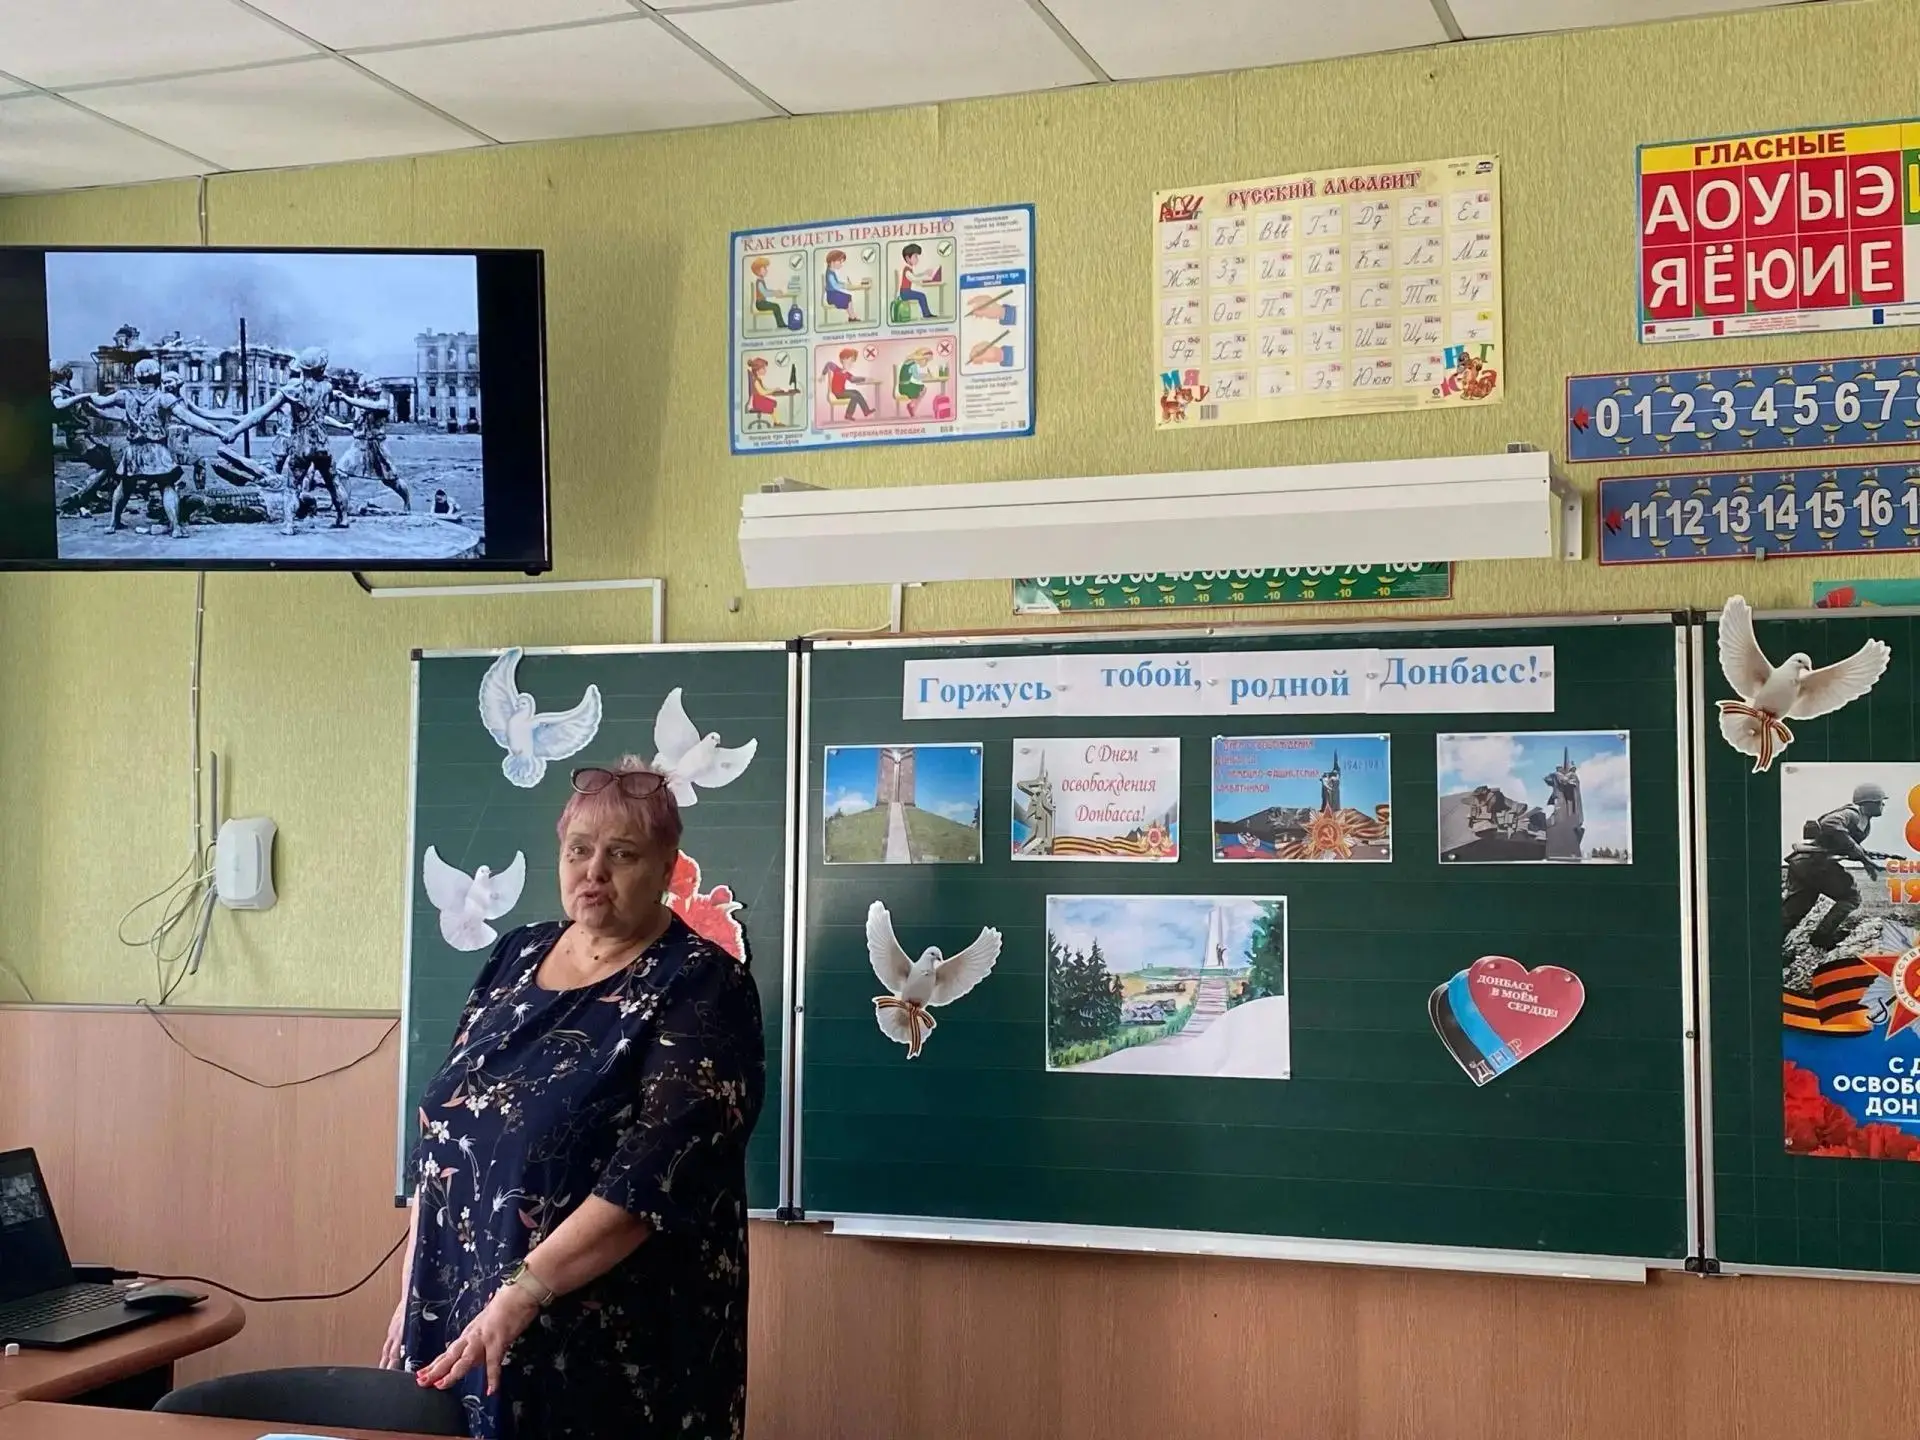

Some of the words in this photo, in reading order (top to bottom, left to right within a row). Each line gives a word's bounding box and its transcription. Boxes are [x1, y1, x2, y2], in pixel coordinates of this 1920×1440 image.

[1694, 132, 1845, 166] ГЛАСНЫЕ
[1227, 178, 1315, 209] РУССКИЙ
[1323, 170, 1421, 195] АЛФАВИТ
[742, 237, 775, 252] КАК
[781, 228, 844, 248] СИДЕТЬ
[849, 221, 955, 241] ПРАВИЛЬНО
[1615, 377, 1629, 387] +1
[1655, 375, 1670, 384] +1
[1696, 372, 1711, 381] +1
[1737, 370, 1752, 379] +1
[1778, 366, 1793, 376] +1
[1818, 363, 1834, 373] +1
[1860, 360, 1877, 370] +1
[1901, 358, 1916, 367] +1
[1596, 398, 1620, 437] 01234567
[1634, 395, 1651, 435] 01234567
[1671, 393, 1695, 433] 01234567
[1712, 390, 1736, 430] 01234567
[1751, 387, 1778, 427] 01234567
[1793, 385, 1819, 426] 01234567
[1835, 382, 1861, 423] 01234567
[1874, 380, 1900, 420] 01234567
[1619, 447, 1630, 456] -1
[1659, 444, 1670, 453] -1
[1701, 442, 1712, 451] -1
[1742, 439, 1753, 448] -1
[1783, 437, 1794, 446] -1
[1824, 435, 1835, 444] -1
[1866, 432, 1878, 441] -1
[1906, 430, 1918, 439] -1
[1656, 480, 1670, 489] +1
[1697, 477, 1711, 486] +1
[1738, 475, 1753, 484] +1
[1780, 473, 1795, 482] +1
[1822, 470, 1837, 479] +1
[1863, 468, 1879, 477] +1
[1625, 501, 1657, 538] 11
[1666, 499, 1705, 536] 12
[1712, 496, 1751, 533] 13
[1758, 493, 1799, 531] 14
[1805, 491, 1845, 529] 15
[1853, 488, 1894, 527] 16
[1901, 487, 1920, 525] 1
[1655, 549, 1666, 557] -1
[1696, 547, 1707, 555] -1
[1737, 544, 1748, 552] -1
[1779, 543, 1790, 552] -1
[1822, 541, 1833, 550] -1
[1863, 539, 1874, 548] -1
[1907, 538, 1918, 546] -1
[1056, 599, 1071, 608] -10
[1089, 598, 1105, 607] -10
[1124, 597, 1141, 606] -10
[1159, 596, 1175, 605] -10
[1193, 594, 1210, 603] -10
[1227, 592, 1245, 601] -10
[1264, 591, 1281, 600] -10
[1298, 590, 1315, 599] -10
[1334, 588, 1352, 598] -10
[1373, 587, 1391, 596] -10
[918, 677, 1052, 709] Горжусь
[1100, 660, 1201, 696] тобой,
[1231, 669, 1349, 705] родной
[1379, 656, 1538, 690] Донбасс!
[1085, 745, 1096, 763] С
[1100, 745, 1138, 762] Днем
[1061, 772, 1156, 796] освобождения
[1076, 803, 1146, 822] Донбасса!
[1477, 975, 1534, 992] ДОНБАСС
[1491, 988, 1500, 996] В
[1502, 990, 1538, 1003] МОЁМ
[1507, 1002, 1558, 1018] СЕРДЦЕ!
[1888, 1056, 1905, 1074] С
[1865, 1097, 1918, 1116] ДОН
